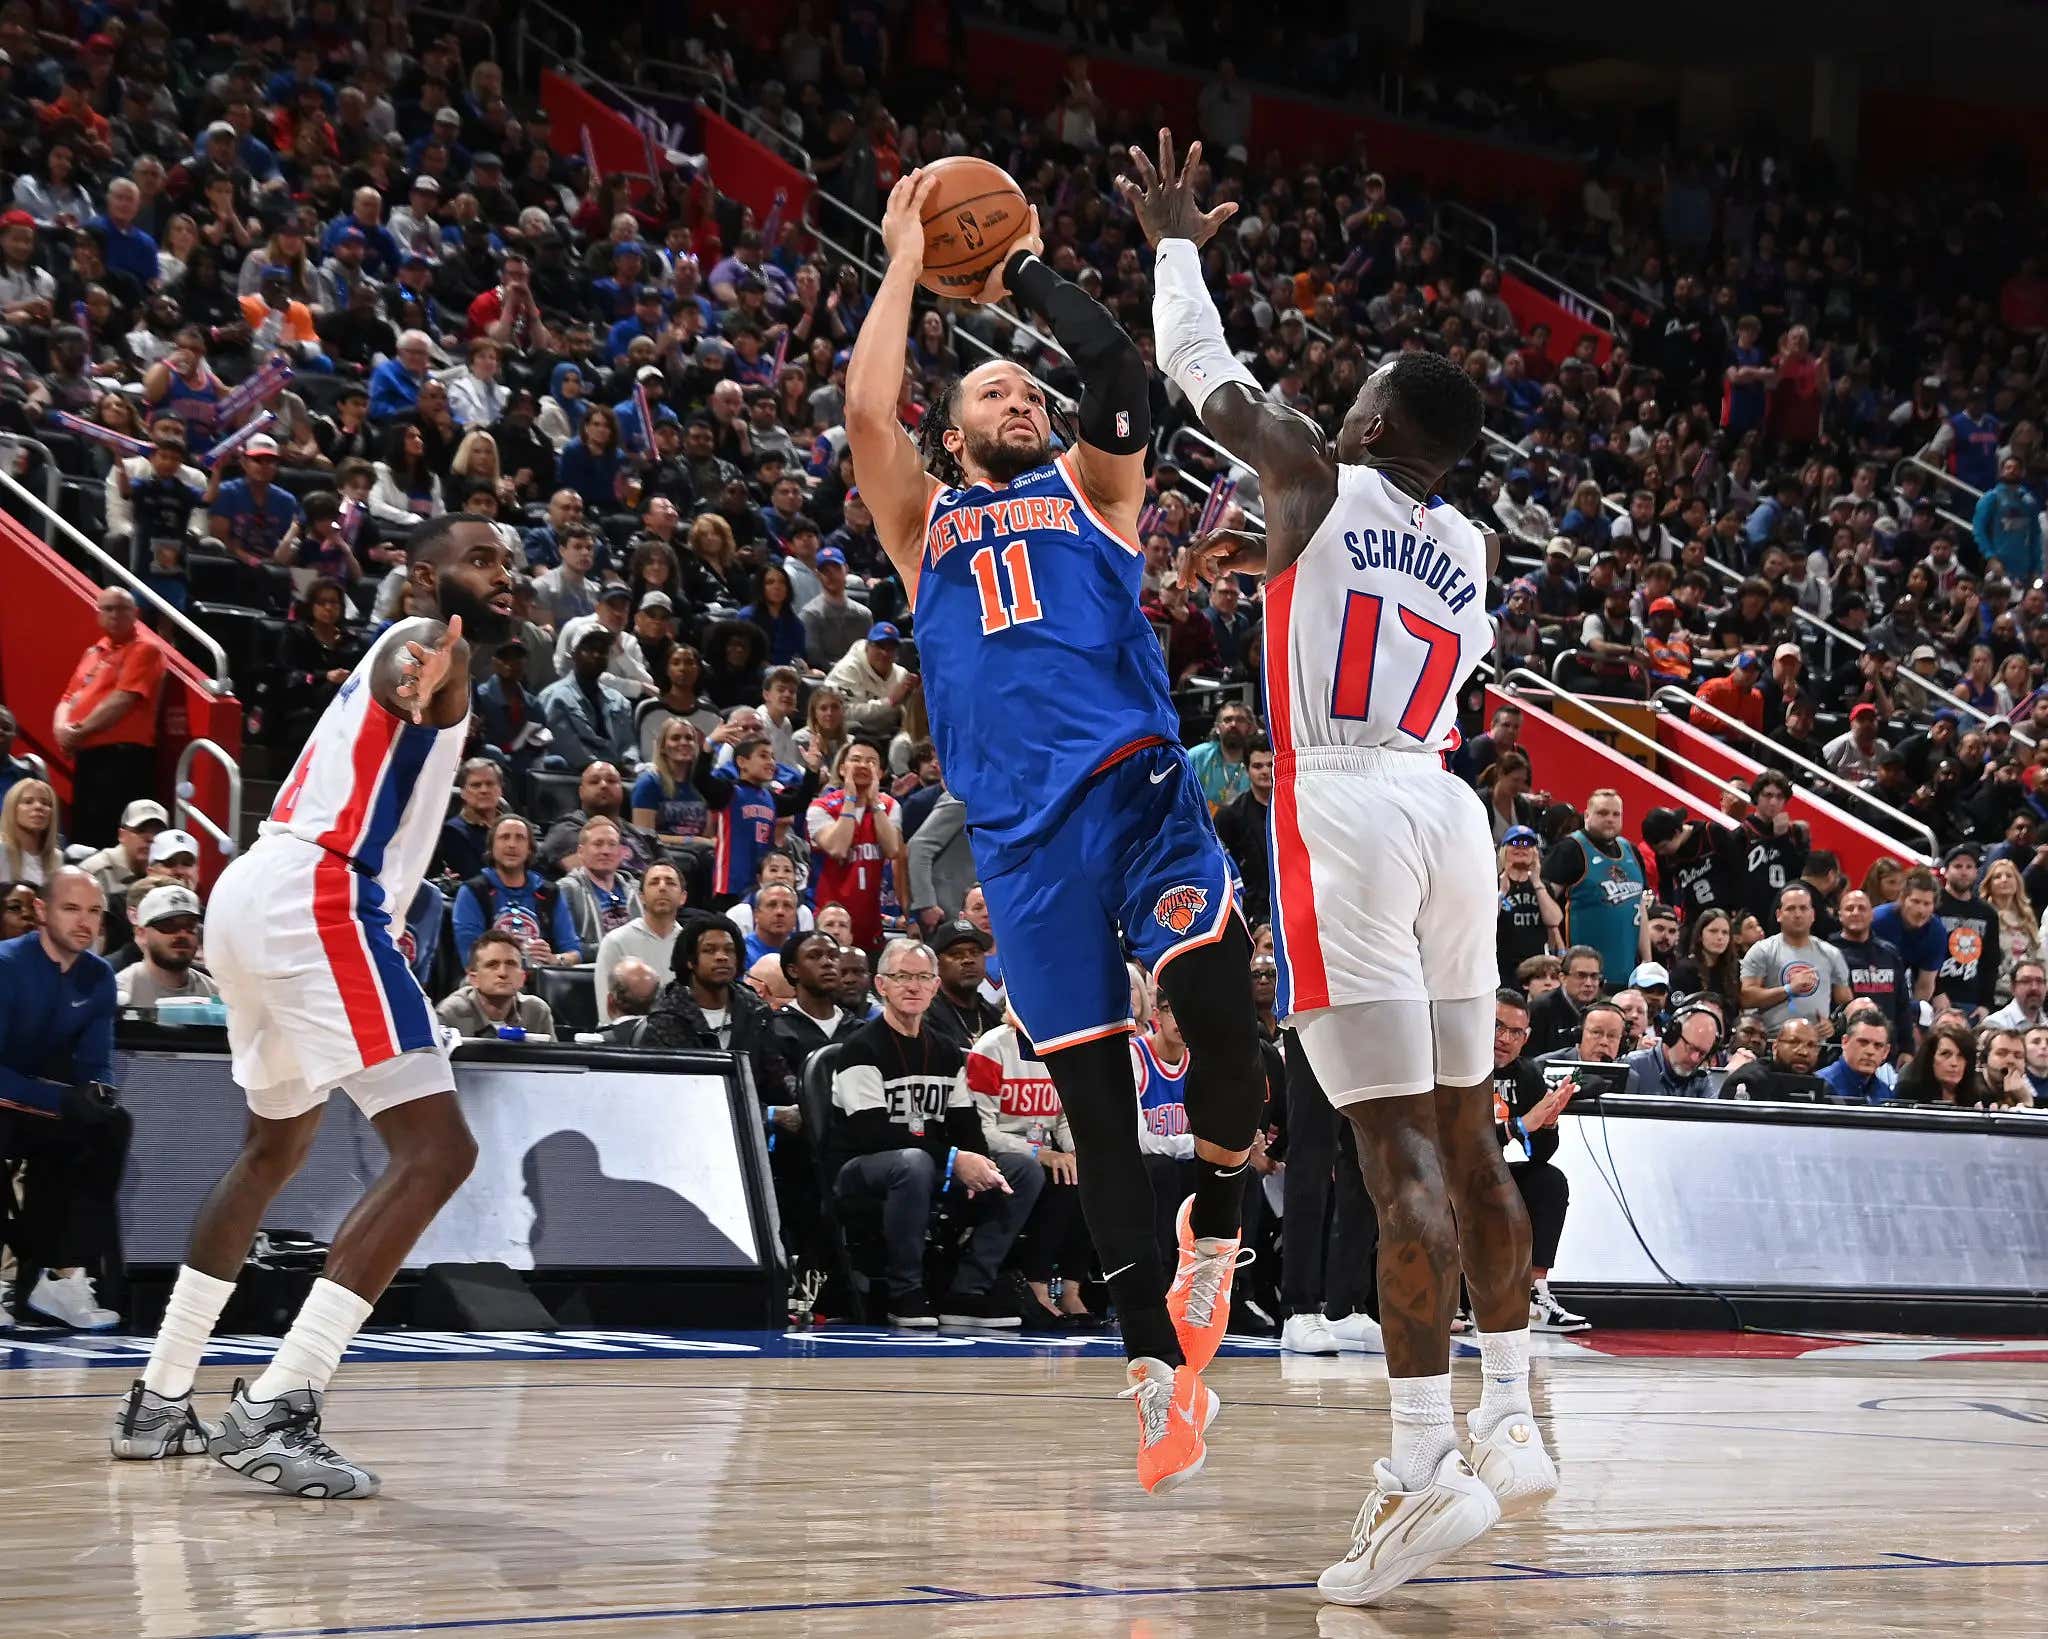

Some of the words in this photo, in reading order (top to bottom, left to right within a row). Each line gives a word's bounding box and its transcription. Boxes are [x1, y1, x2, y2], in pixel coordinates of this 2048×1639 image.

[929, 507, 982, 570] NEW
[986, 497, 1079, 537] YORK
[1344, 529, 1477, 615] SCHRÖDER
[970, 540, 1043, 636] 11
[1330, 588, 1461, 743] 17
[1158, 888, 1205, 922] KNICKS
[1514, 912, 1539, 926] CITY
